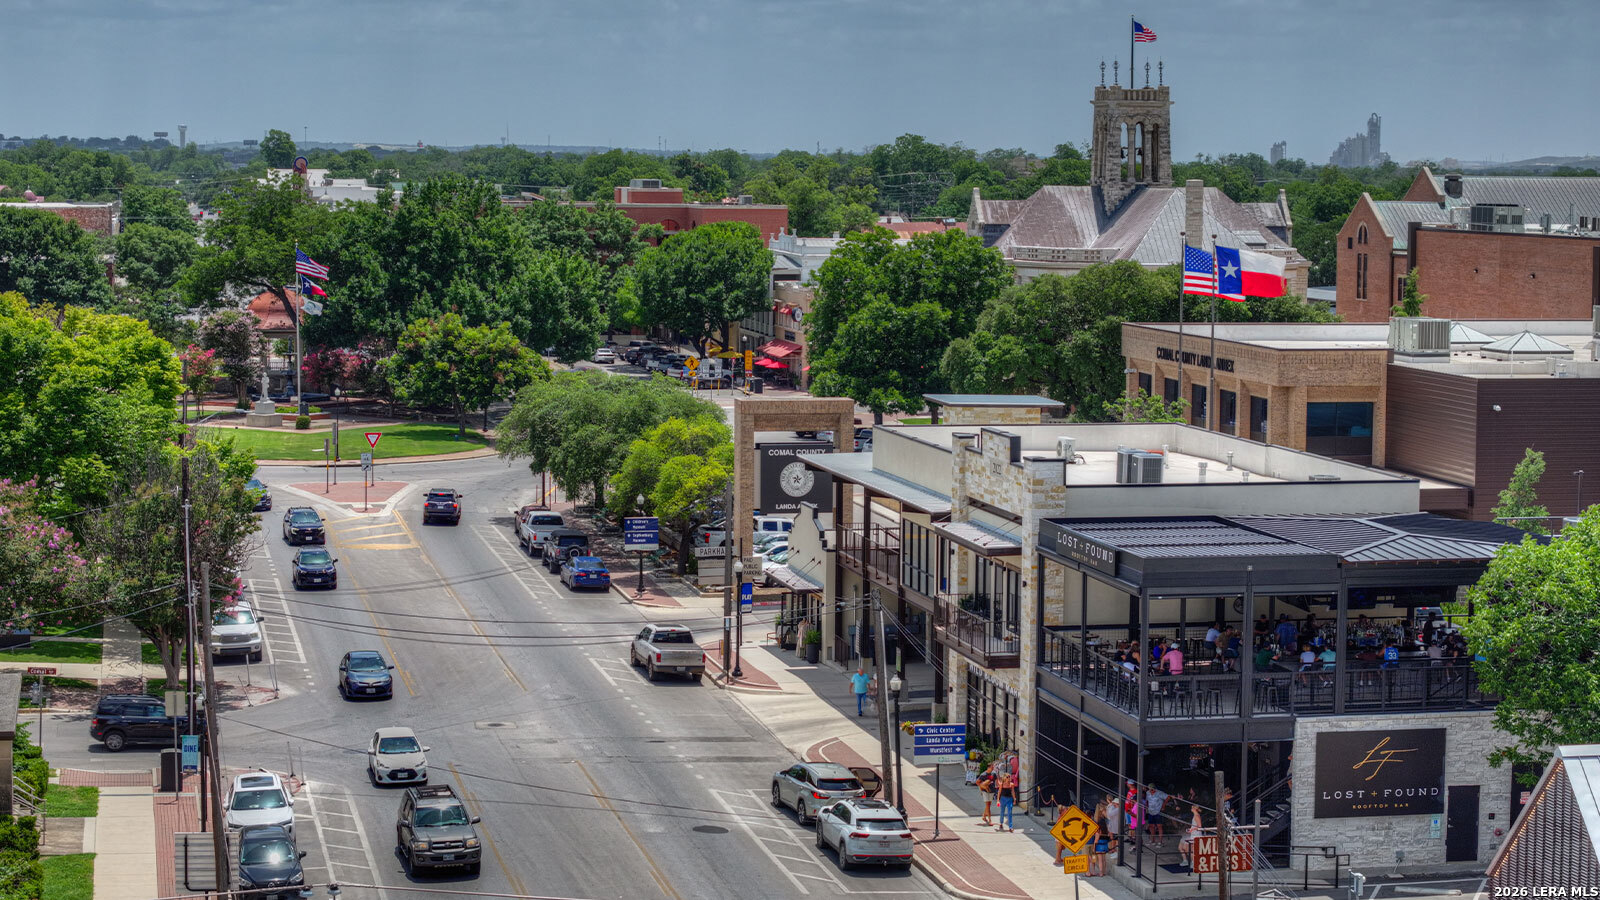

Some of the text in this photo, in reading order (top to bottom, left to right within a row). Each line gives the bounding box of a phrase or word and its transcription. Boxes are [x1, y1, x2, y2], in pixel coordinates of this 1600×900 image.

[1157, 347, 1174, 361] COMAL
[1175, 350, 1196, 365] CUNTY
[1197, 354, 1212, 368] LAND
[1057, 531, 1078, 549] LOST
[1085, 543, 1114, 563] FOUND
[741, 593, 752, 601] PLAY
[1388, 652, 1397, 660] 33
[183, 744, 197, 752] DINE
[1323, 790, 1365, 800] LOST
[1384, 787, 1439, 797] FOUND
[1199, 836, 1238, 855] MUK
[1066, 857, 1086, 865] TRAFFIC
